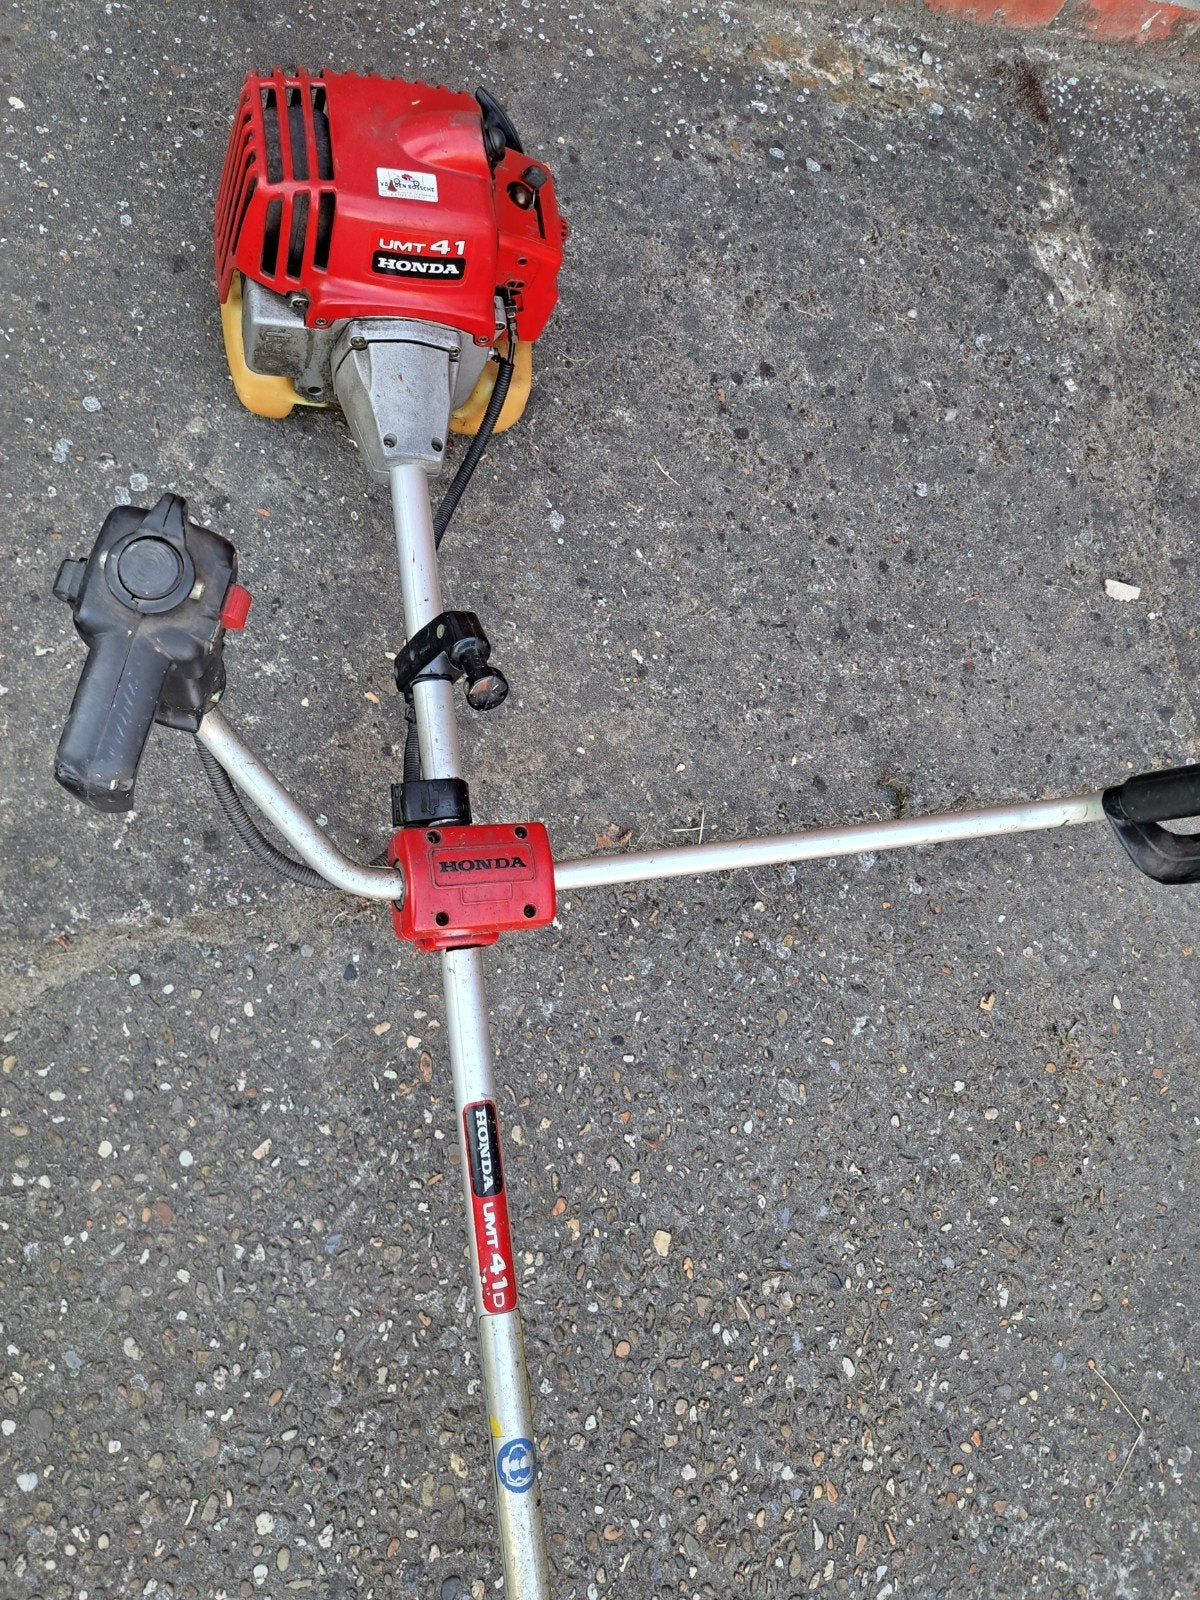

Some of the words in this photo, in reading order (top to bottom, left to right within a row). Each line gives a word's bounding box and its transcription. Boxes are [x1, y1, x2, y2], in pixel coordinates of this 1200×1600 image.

[379, 238, 426, 253] UMT
[430, 240, 466, 255] 41
[378, 257, 460, 275] HONDA
[439, 857, 527, 873] HONDA
[475, 1105, 494, 1193] HONDA
[482, 1202, 499, 1249] UMT
